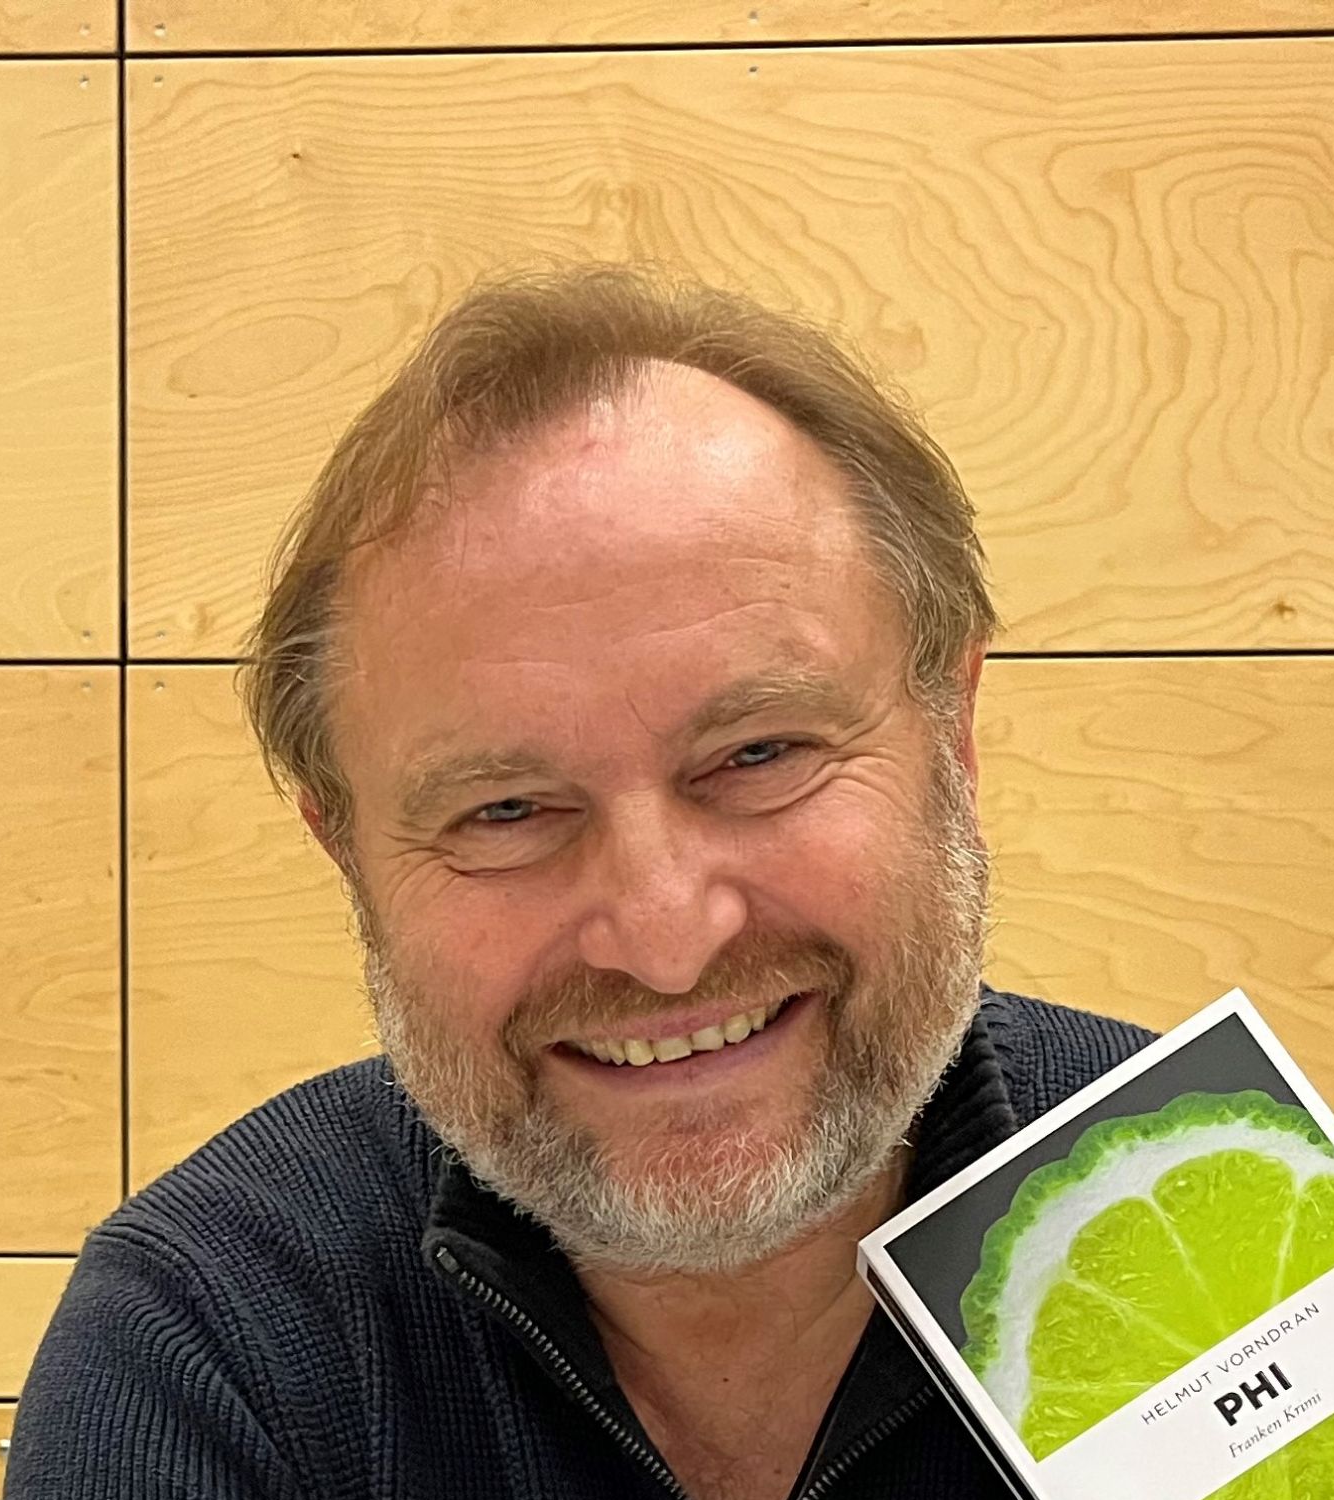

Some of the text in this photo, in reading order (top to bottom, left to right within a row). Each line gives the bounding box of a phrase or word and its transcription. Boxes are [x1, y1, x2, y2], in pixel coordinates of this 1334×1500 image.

[1141, 1302, 1320, 1426] HELMUT VORNDRAN
[1213, 1362, 1293, 1427] PHI
[1228, 1391, 1322, 1459] Franken Krimi
